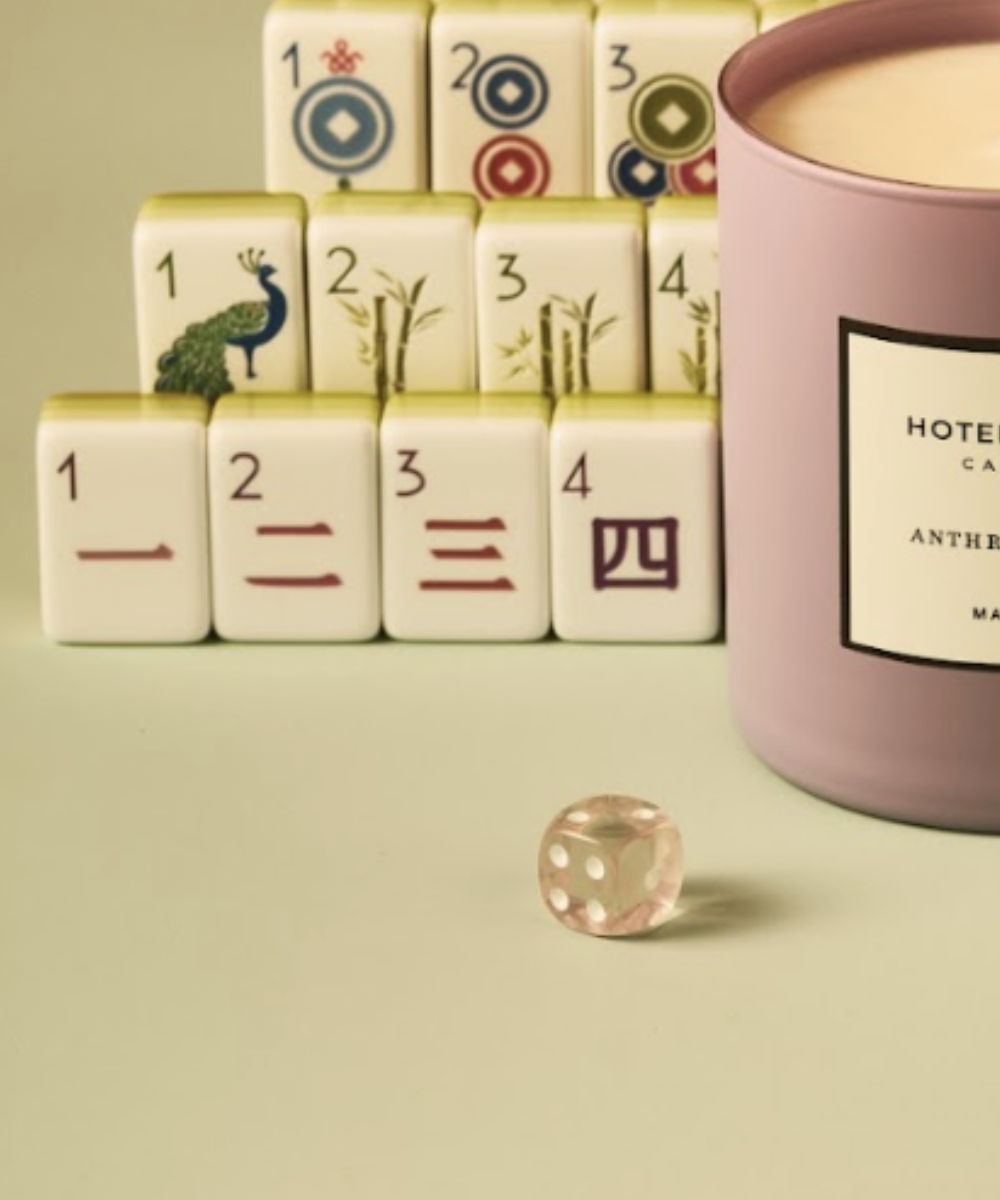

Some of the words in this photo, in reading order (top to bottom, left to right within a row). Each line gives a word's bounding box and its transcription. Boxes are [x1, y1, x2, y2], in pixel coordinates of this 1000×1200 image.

[282, 40, 300, 88] 1
[451, 43, 481, 90] 2
[608, 45, 637, 90] 3
[155, 252, 177, 298] 1
[328, 248, 358, 294] 2
[497, 255, 527, 300] 3
[659, 254, 689, 299] 4
[56, 452, 79, 501] 1
[230, 453, 263, 500] 2
[396, 450, 427, 497] 3
[562, 453, 593, 499] 4
[244, 522, 343, 587] 二
[418, 517, 516, 592] 三
[592, 517, 679, 591] 四
